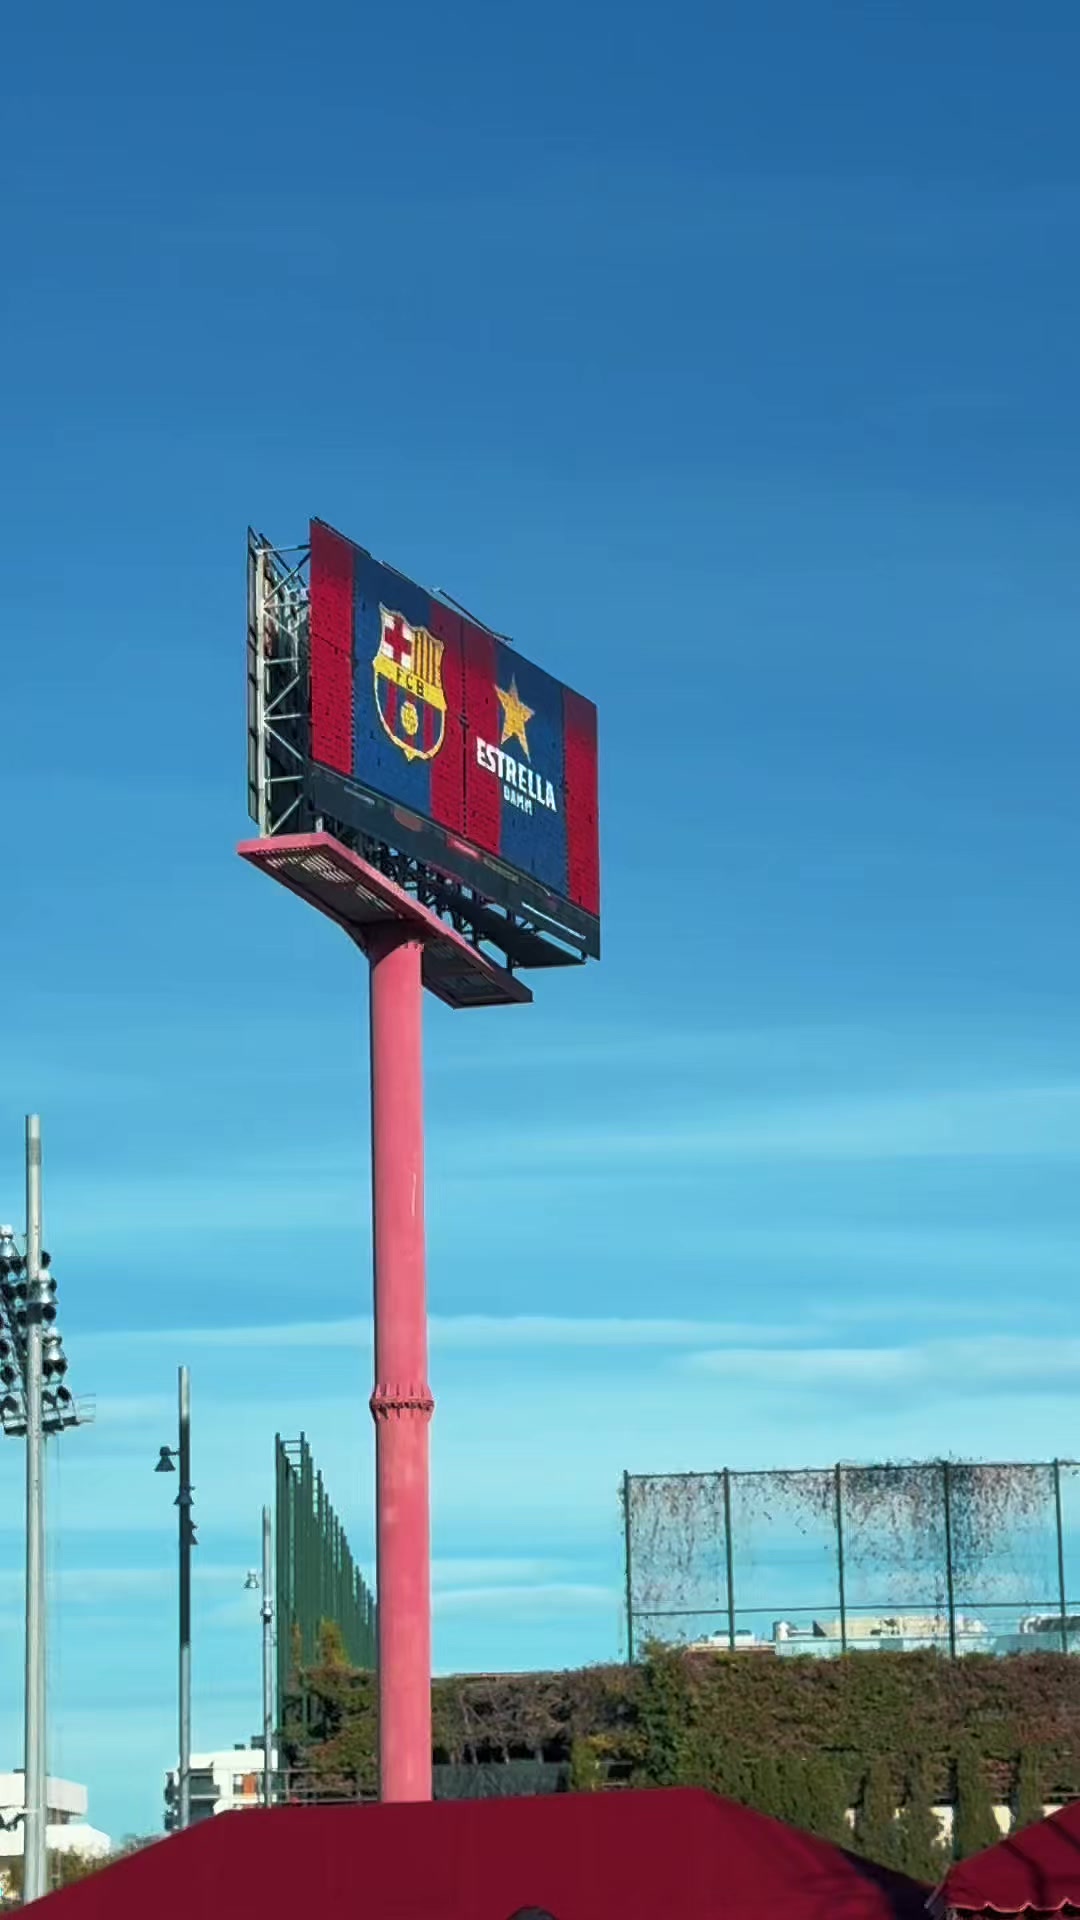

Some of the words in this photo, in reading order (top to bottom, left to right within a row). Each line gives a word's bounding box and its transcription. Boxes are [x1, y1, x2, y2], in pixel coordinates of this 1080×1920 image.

[396, 668, 425, 697] FCB
[476, 736, 557, 812] ESTRELLA
[503, 784, 533, 816] DAMM
